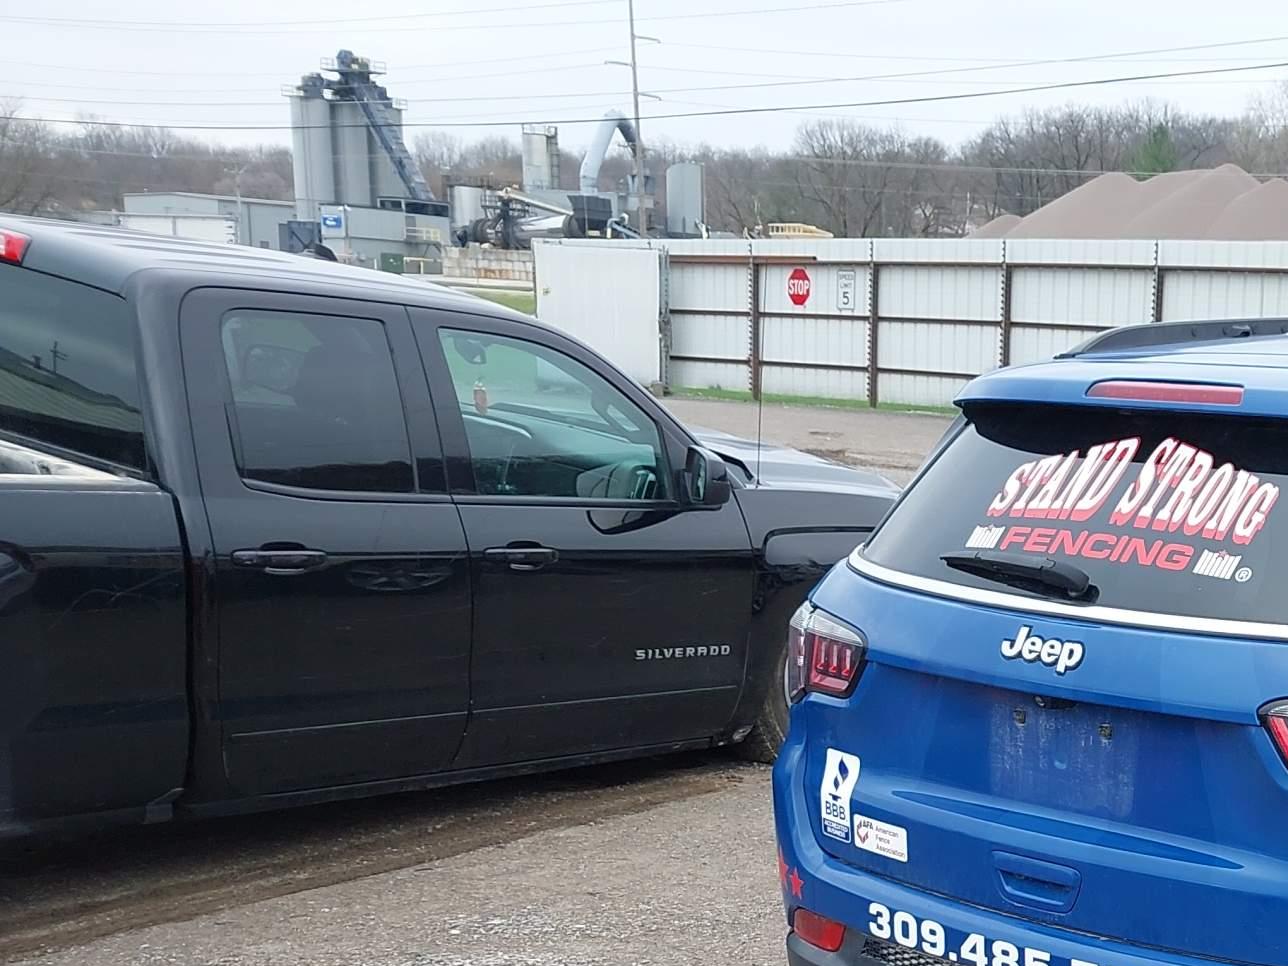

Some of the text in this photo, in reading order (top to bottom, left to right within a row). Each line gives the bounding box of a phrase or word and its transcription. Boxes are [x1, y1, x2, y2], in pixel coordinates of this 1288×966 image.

[789, 279, 810, 296] STOP
[842, 291, 850, 305] 5
[987, 437, 1280, 545] STAND STRONG
[1000, 526, 1194, 571] FENCING
[635, 645, 730, 660] SILVERADO
[1000, 624, 1085, 675] Jeep
[825, 801, 846, 820] BBB
[862, 819, 874, 831] AFA
[875, 825, 899, 838] American
